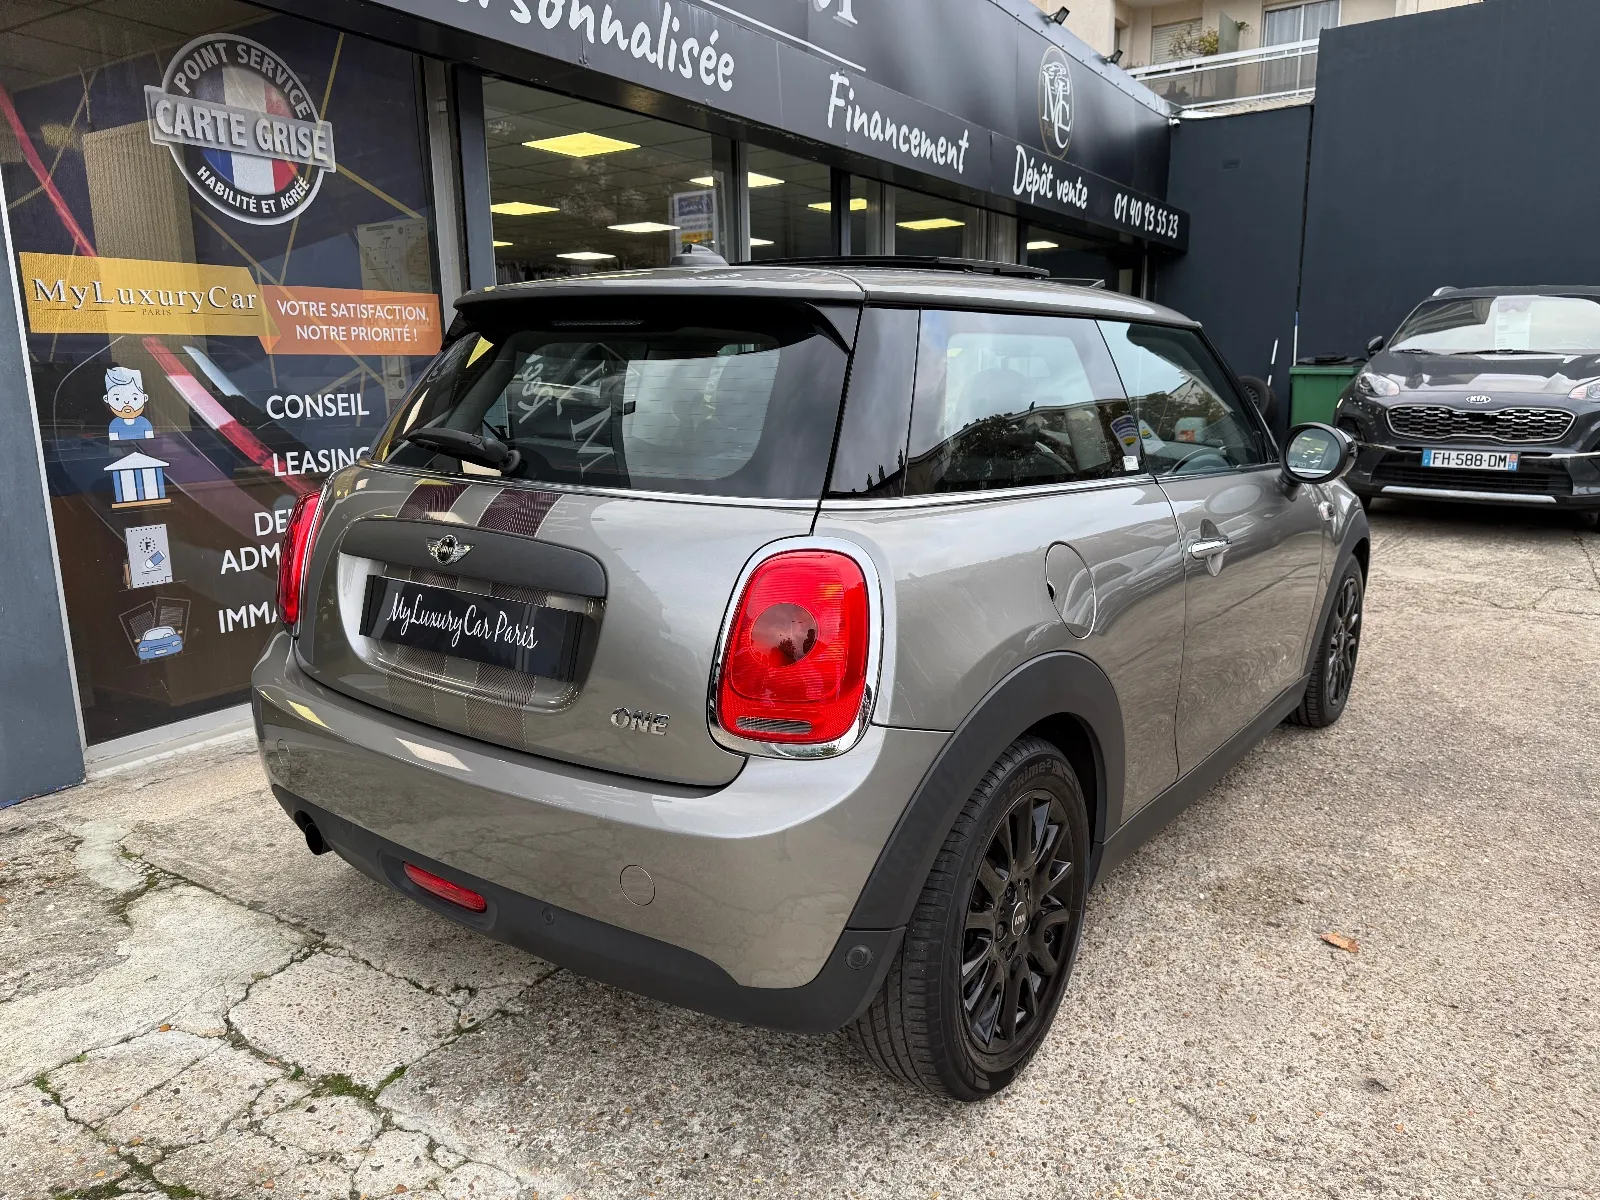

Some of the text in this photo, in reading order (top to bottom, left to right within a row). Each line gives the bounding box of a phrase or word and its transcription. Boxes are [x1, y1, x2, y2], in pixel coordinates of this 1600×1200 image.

[457, 0, 734, 92] sonnalisée
[173, 42, 311, 118] POINT SERVICE
[155, 99, 328, 160] CARTE GRISE
[827, 71, 969, 174] Financement
[197, 166, 258, 213] HABILITÉ
[261, 200, 277, 214] ET
[1013, 145, 1088, 209] Dépôt vente
[1114, 192, 1179, 239] 01 40 93 55 23
[32, 278, 257, 313] MyLuxuryCar
[142, 308, 172, 316] PARIS
[277, 300, 327, 317] VOTRE
[331, 302, 430, 322] SATISFACTION,
[296, 325, 347, 340] NOTRE
[266, 393, 370, 419] CONSEIL
[1432, 452, 1507, 468] FH-588-DM
[254, 509, 290, 536] DE
[494, 610, 538, 649] Paris
[610, 707, 670, 736] ONE
